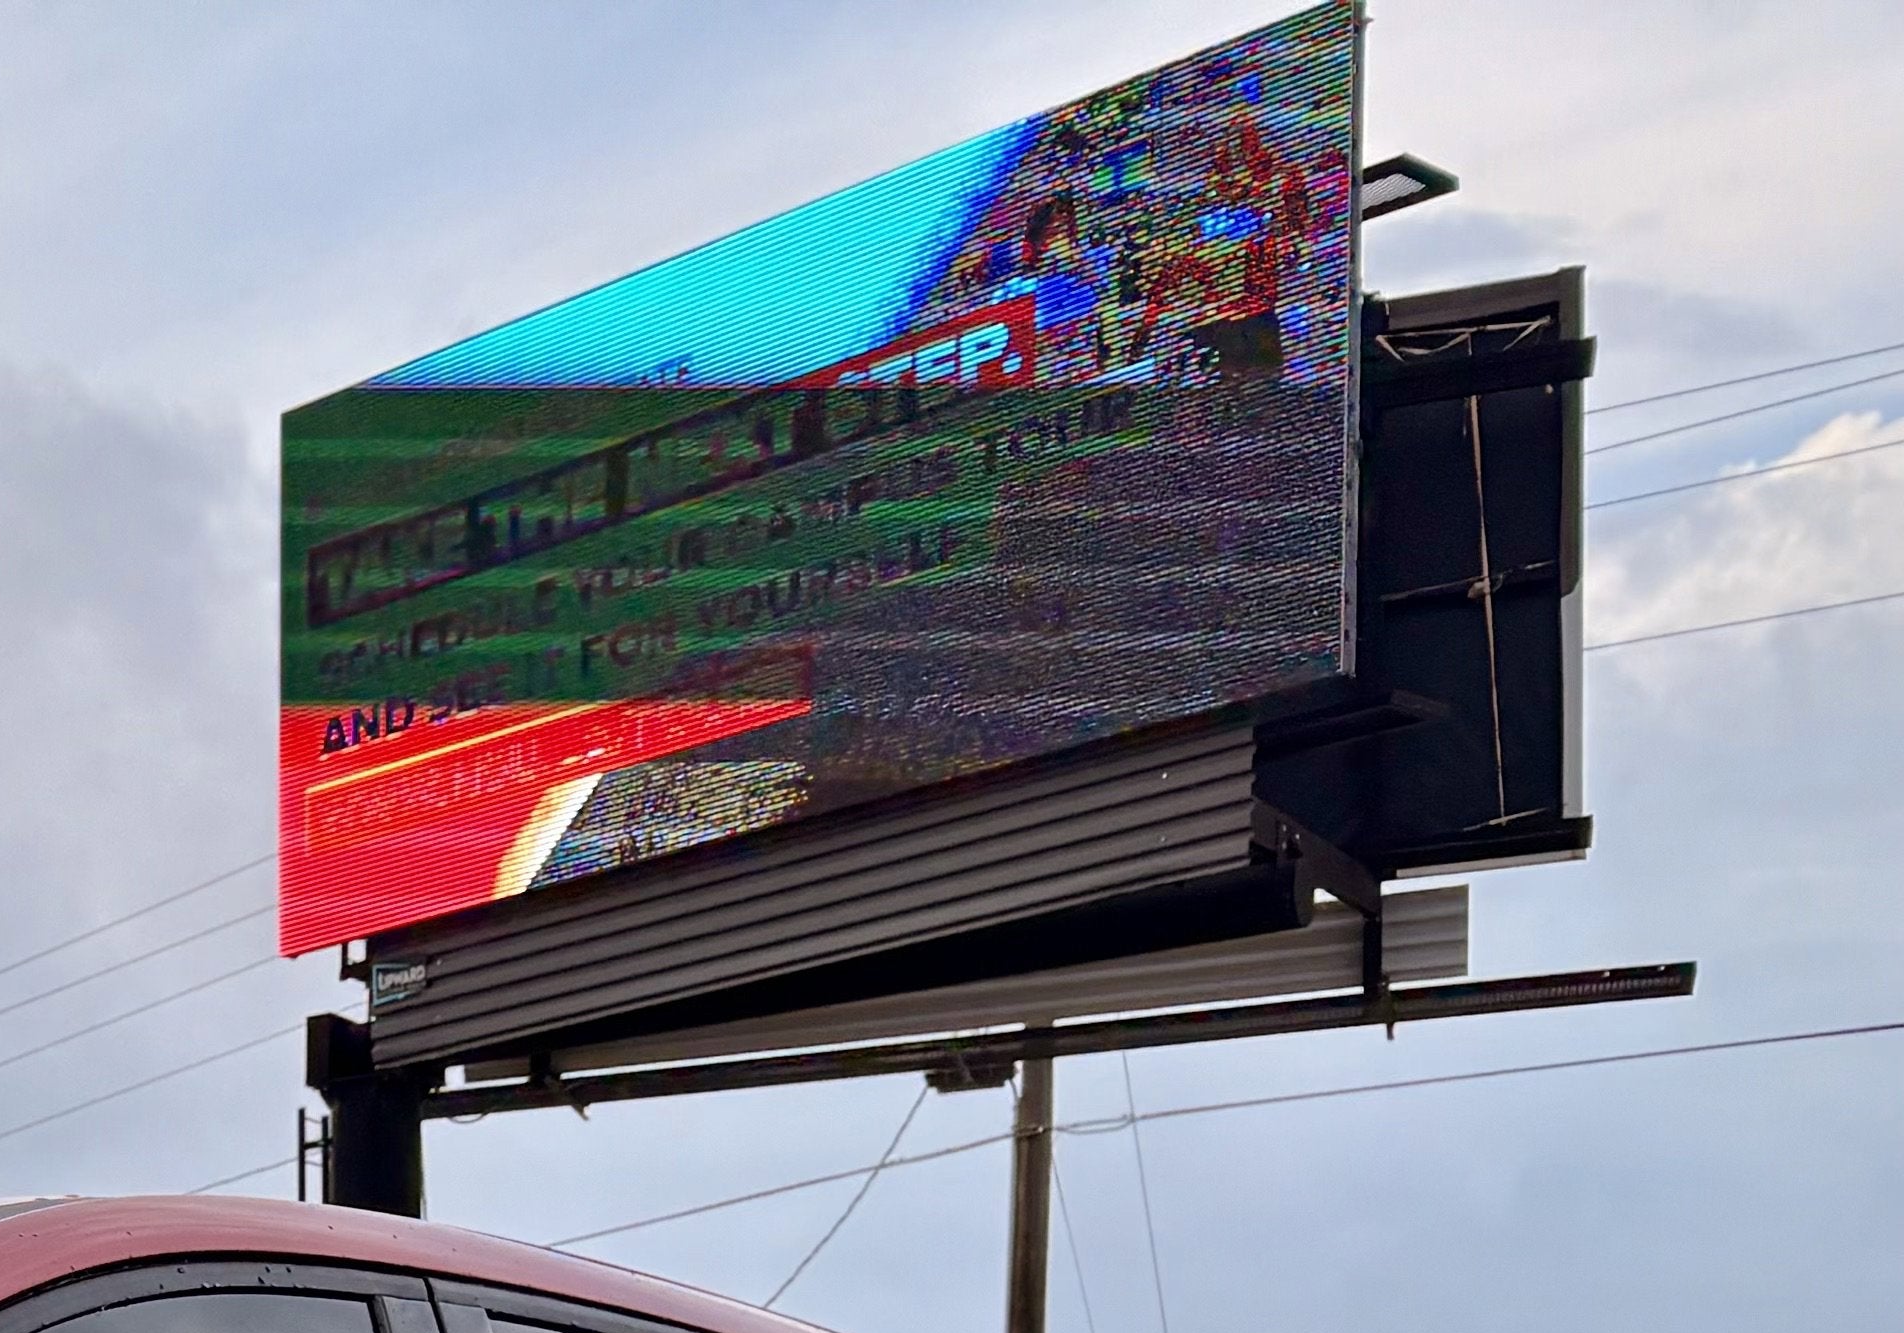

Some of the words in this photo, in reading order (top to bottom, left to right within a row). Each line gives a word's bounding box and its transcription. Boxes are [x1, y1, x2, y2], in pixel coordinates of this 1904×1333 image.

[823, 311, 1024, 440] STEP.
[578, 523, 709, 607] YOUR
[726, 441, 958, 561] CAMPUS
[979, 384, 1133, 480] TOUR
[319, 691, 413, 757] AND
[427, 663, 504, 724] SEE
[579, 609, 677, 678] FOR
[697, 519, 965, 642] YOURSELF
